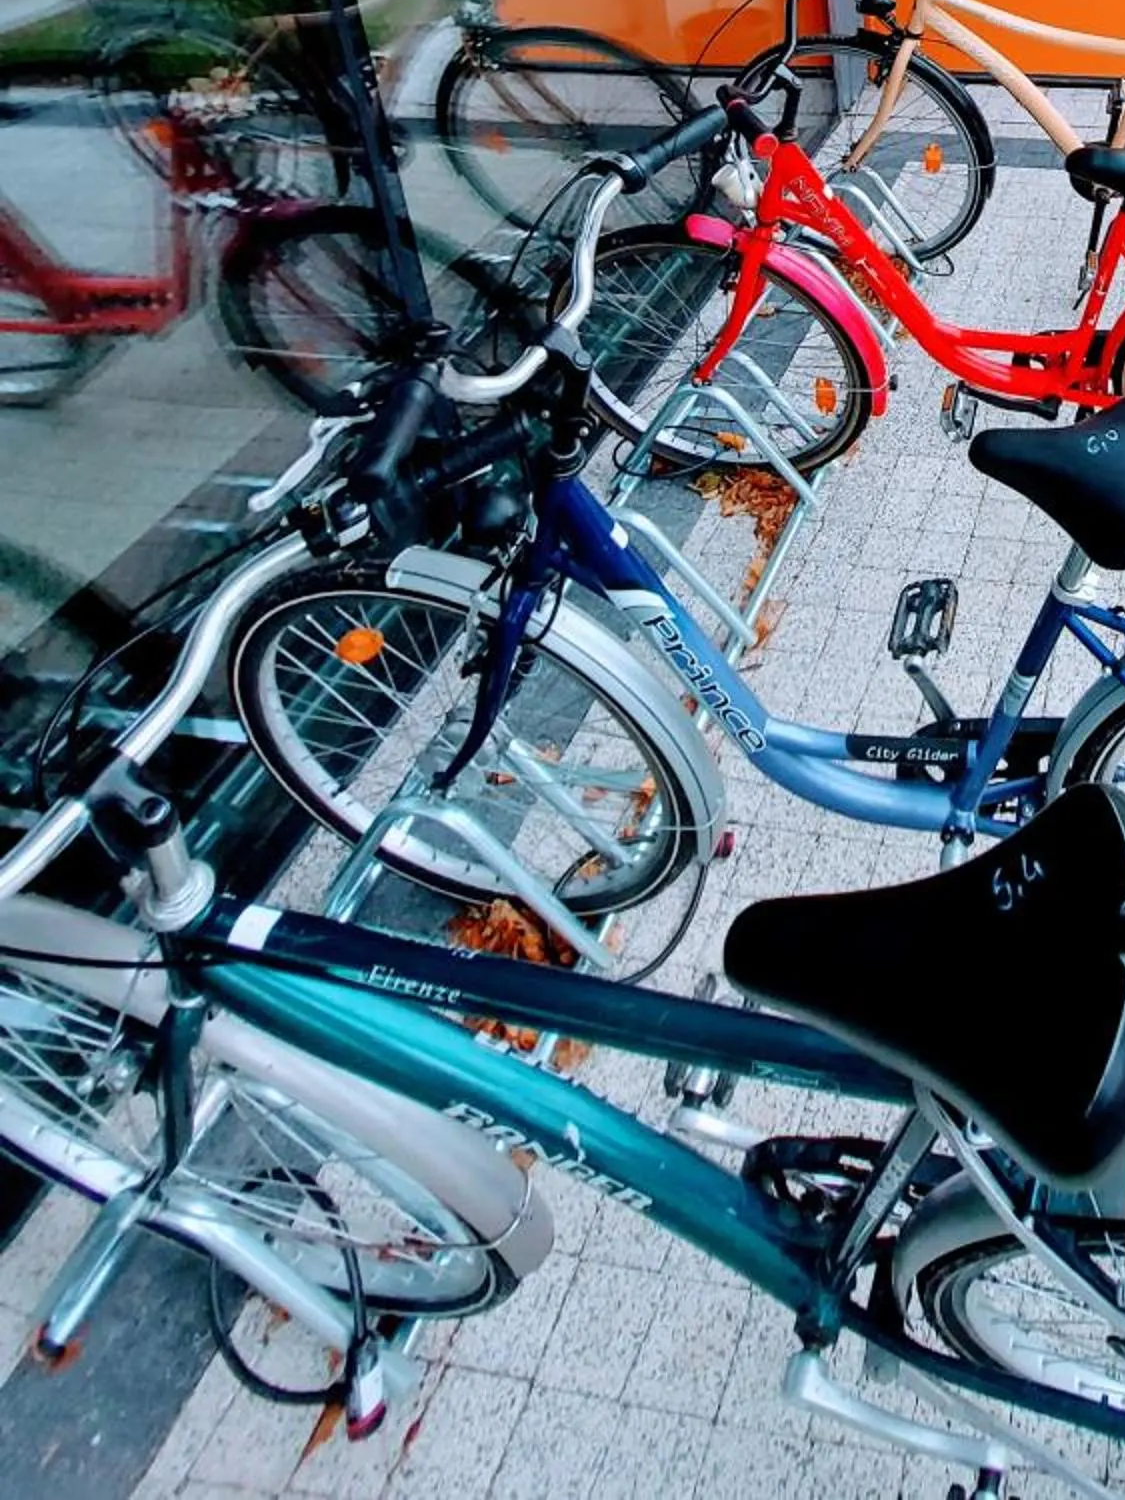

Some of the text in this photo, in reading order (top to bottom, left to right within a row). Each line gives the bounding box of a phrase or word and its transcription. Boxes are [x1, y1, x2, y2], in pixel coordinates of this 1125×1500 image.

[641, 614, 766, 753] Prince
[865, 745, 900, 761] City
[365, 963, 462, 1005] Firenze
